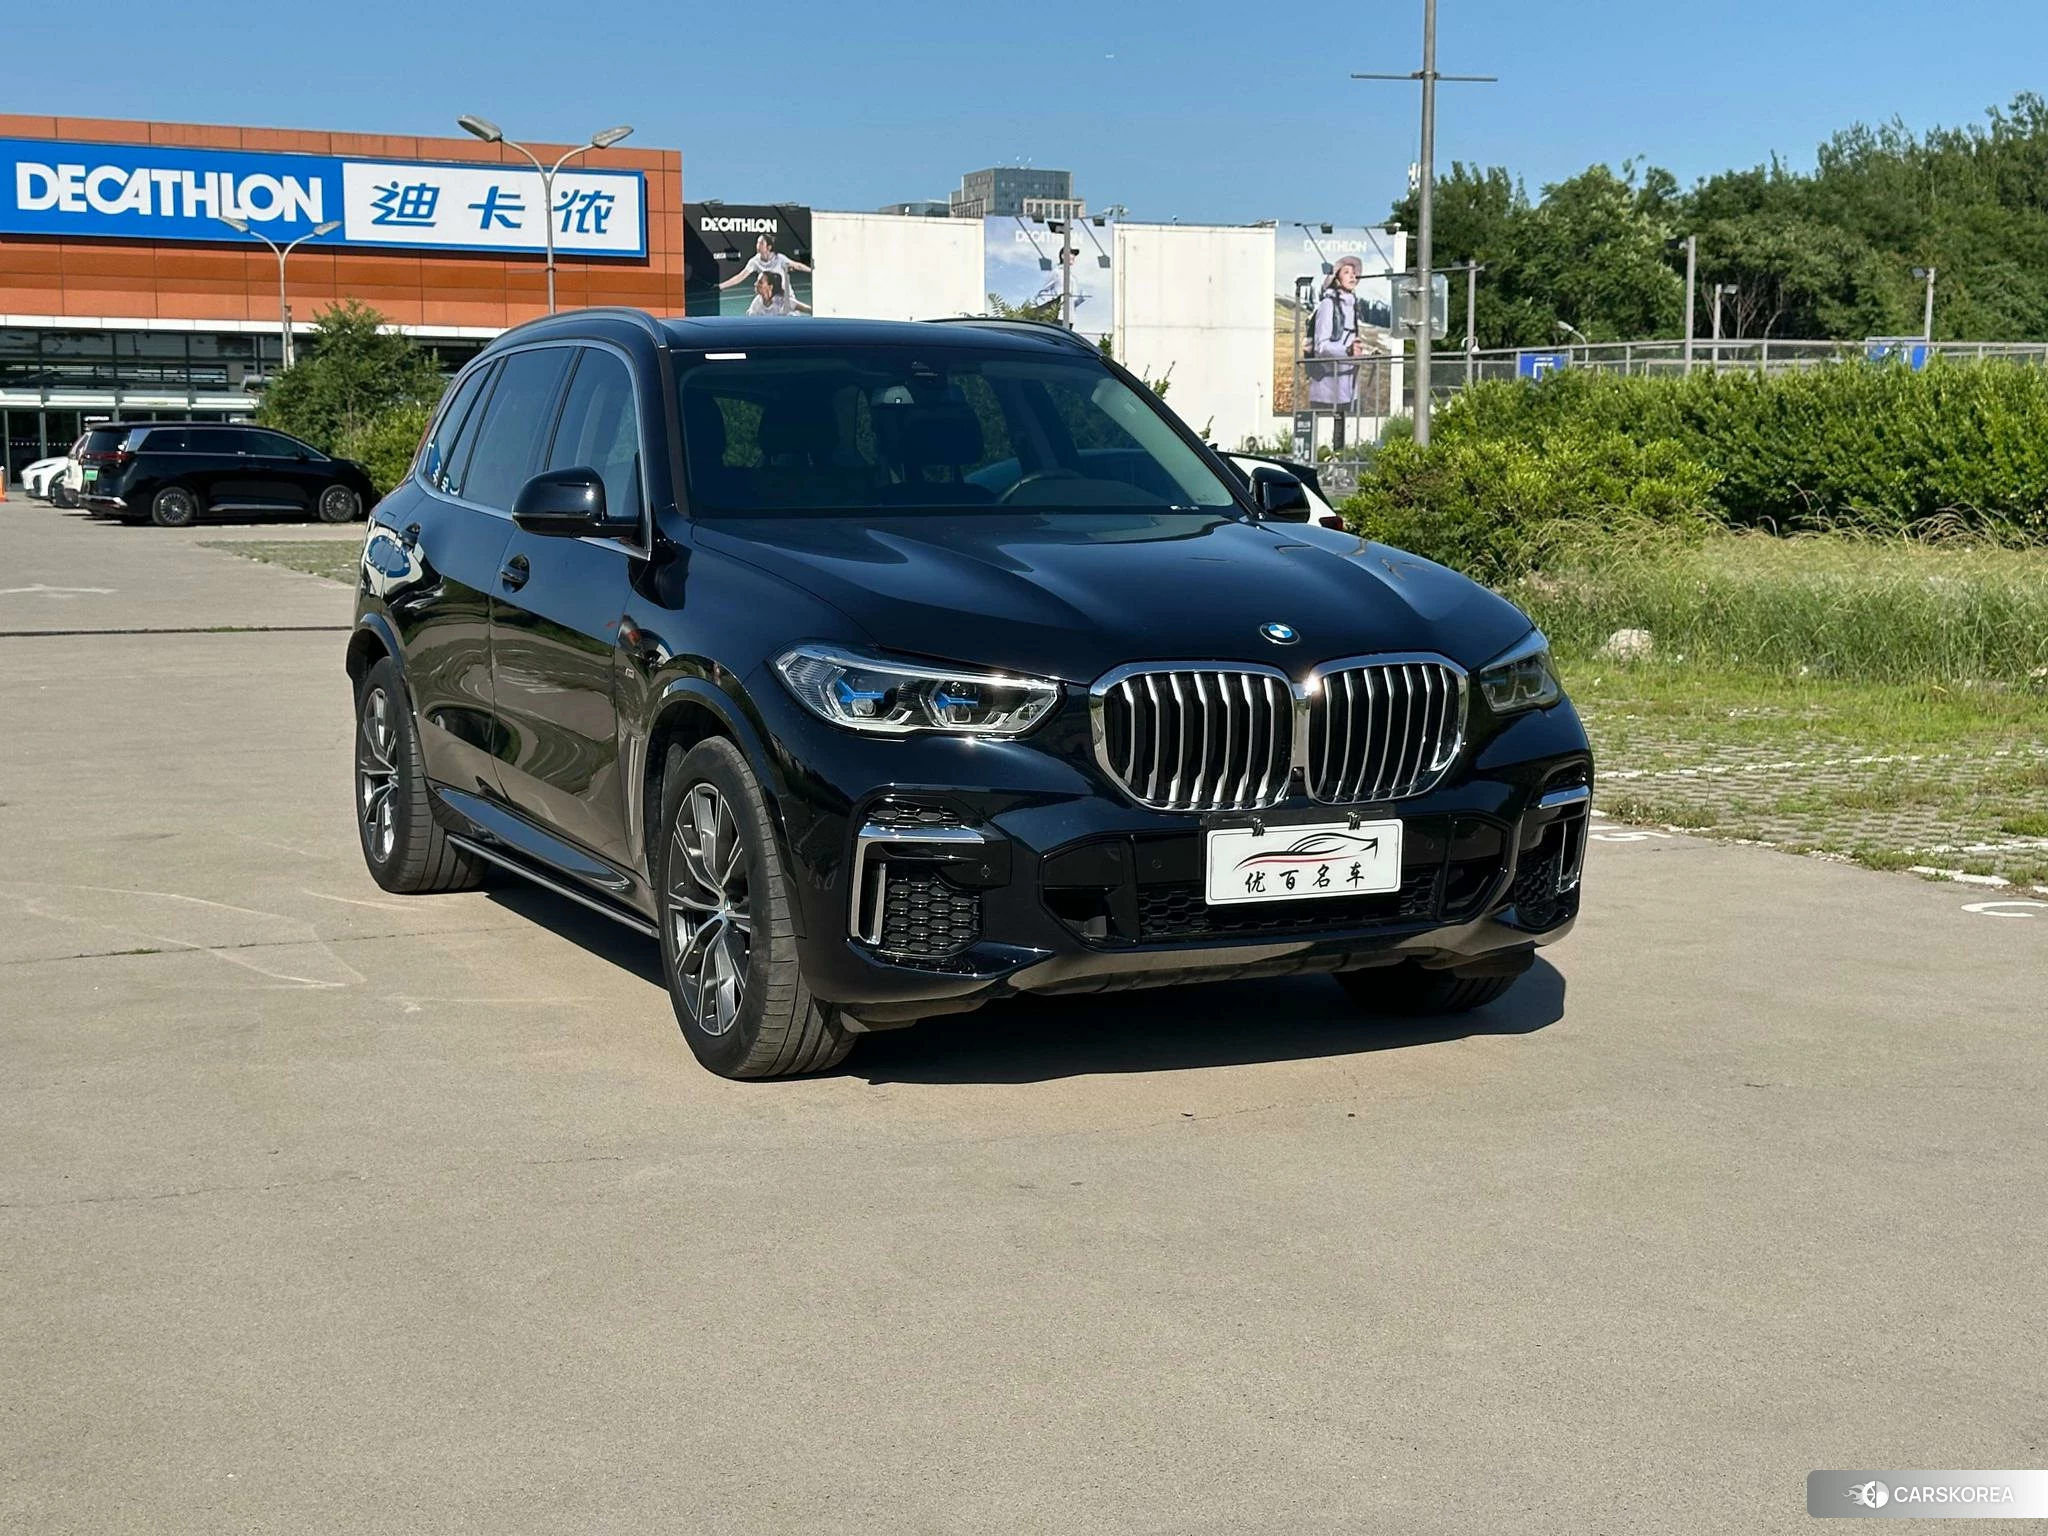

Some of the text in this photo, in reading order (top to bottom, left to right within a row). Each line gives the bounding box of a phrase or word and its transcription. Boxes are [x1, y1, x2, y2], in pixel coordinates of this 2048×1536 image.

[16, 162, 323, 223] DECATHLON
[370, 180, 615, 235] 迪卡侬
[701, 217, 778, 233] DECATHLON
[1245, 862, 1365, 893] 优百名车
